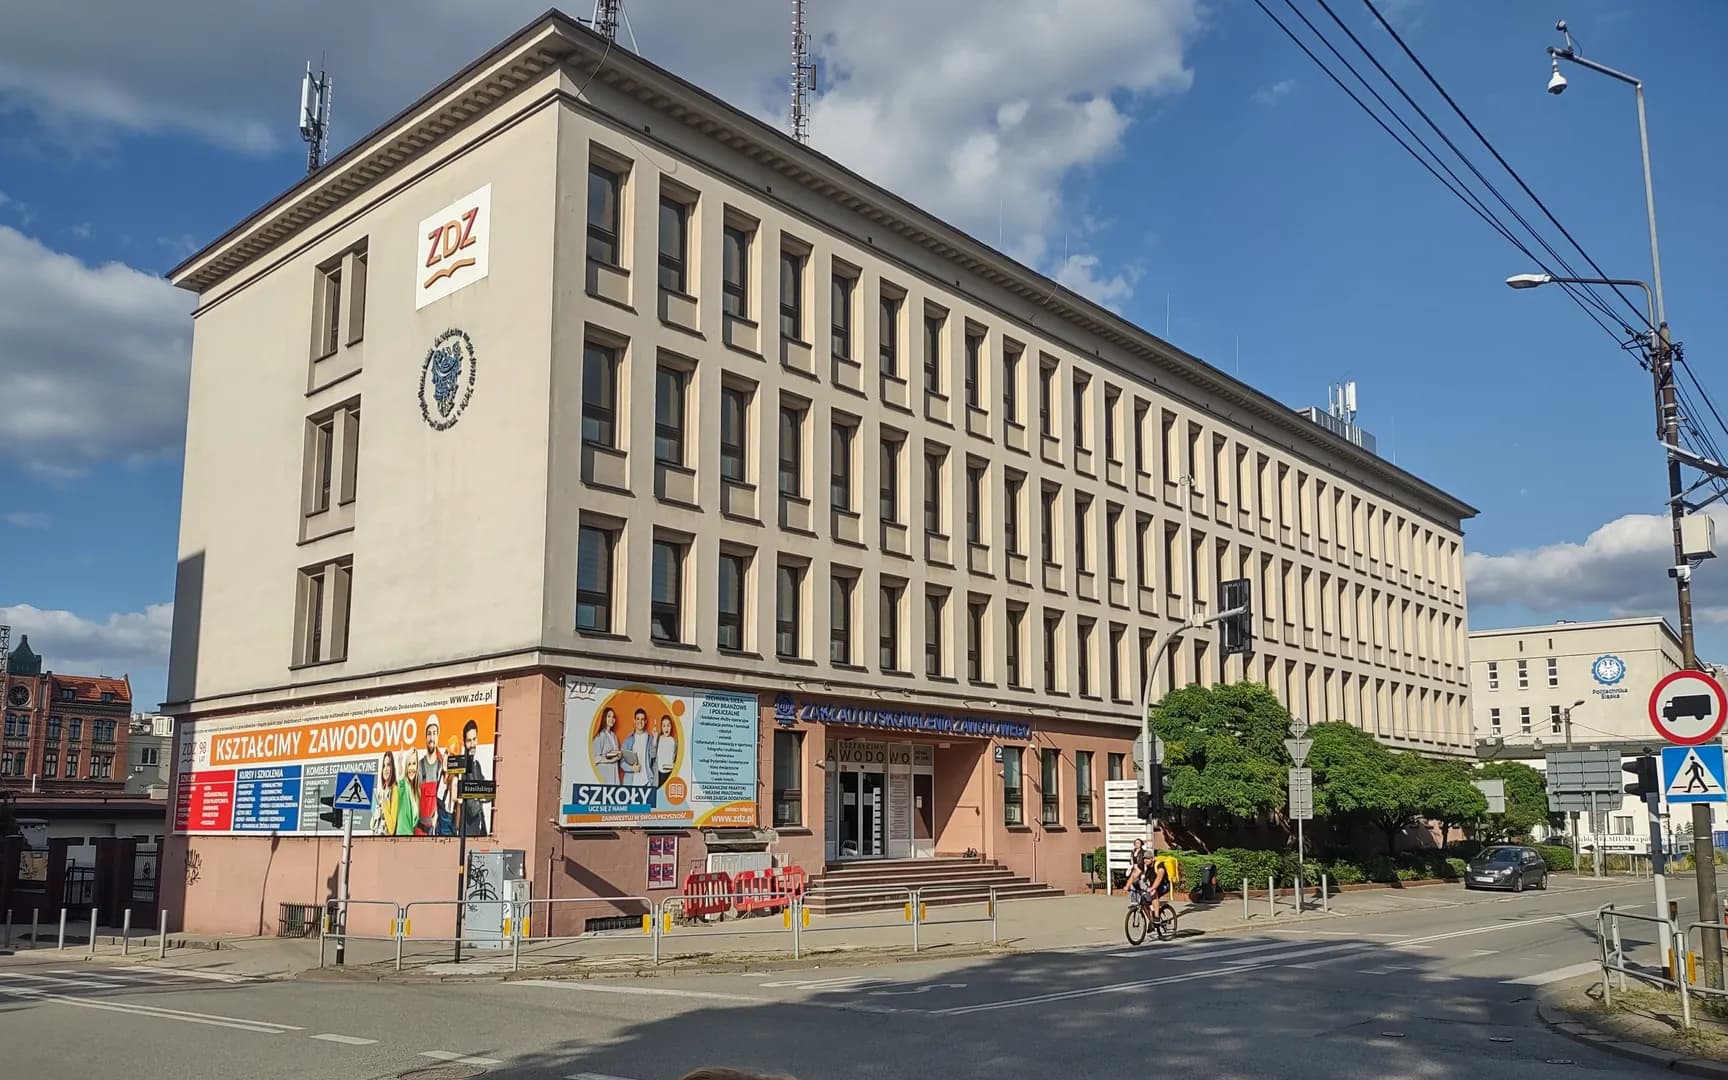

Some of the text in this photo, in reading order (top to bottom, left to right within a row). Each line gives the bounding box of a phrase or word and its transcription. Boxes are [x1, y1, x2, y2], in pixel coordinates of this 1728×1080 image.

[425, 206, 479, 267] ZDZ
[570, 680, 596, 695] ZDZ
[450, 689, 493, 704] www.zdz.pl
[215, 718, 417, 762] KSZTAŁCIMY ZAWODOWO
[182, 742, 197, 756] ZDZ
[826, 749, 910, 764] AWODOWO
[995, 747, 1003, 758] 2
[257, 768, 283, 779] SZKOLENIA
[306, 761, 376, 776] KOMISJE EGZAMINACYJNE
[578, 785, 651, 806] SZKOŁY
[711, 814, 754, 824] www.zdz.pl
